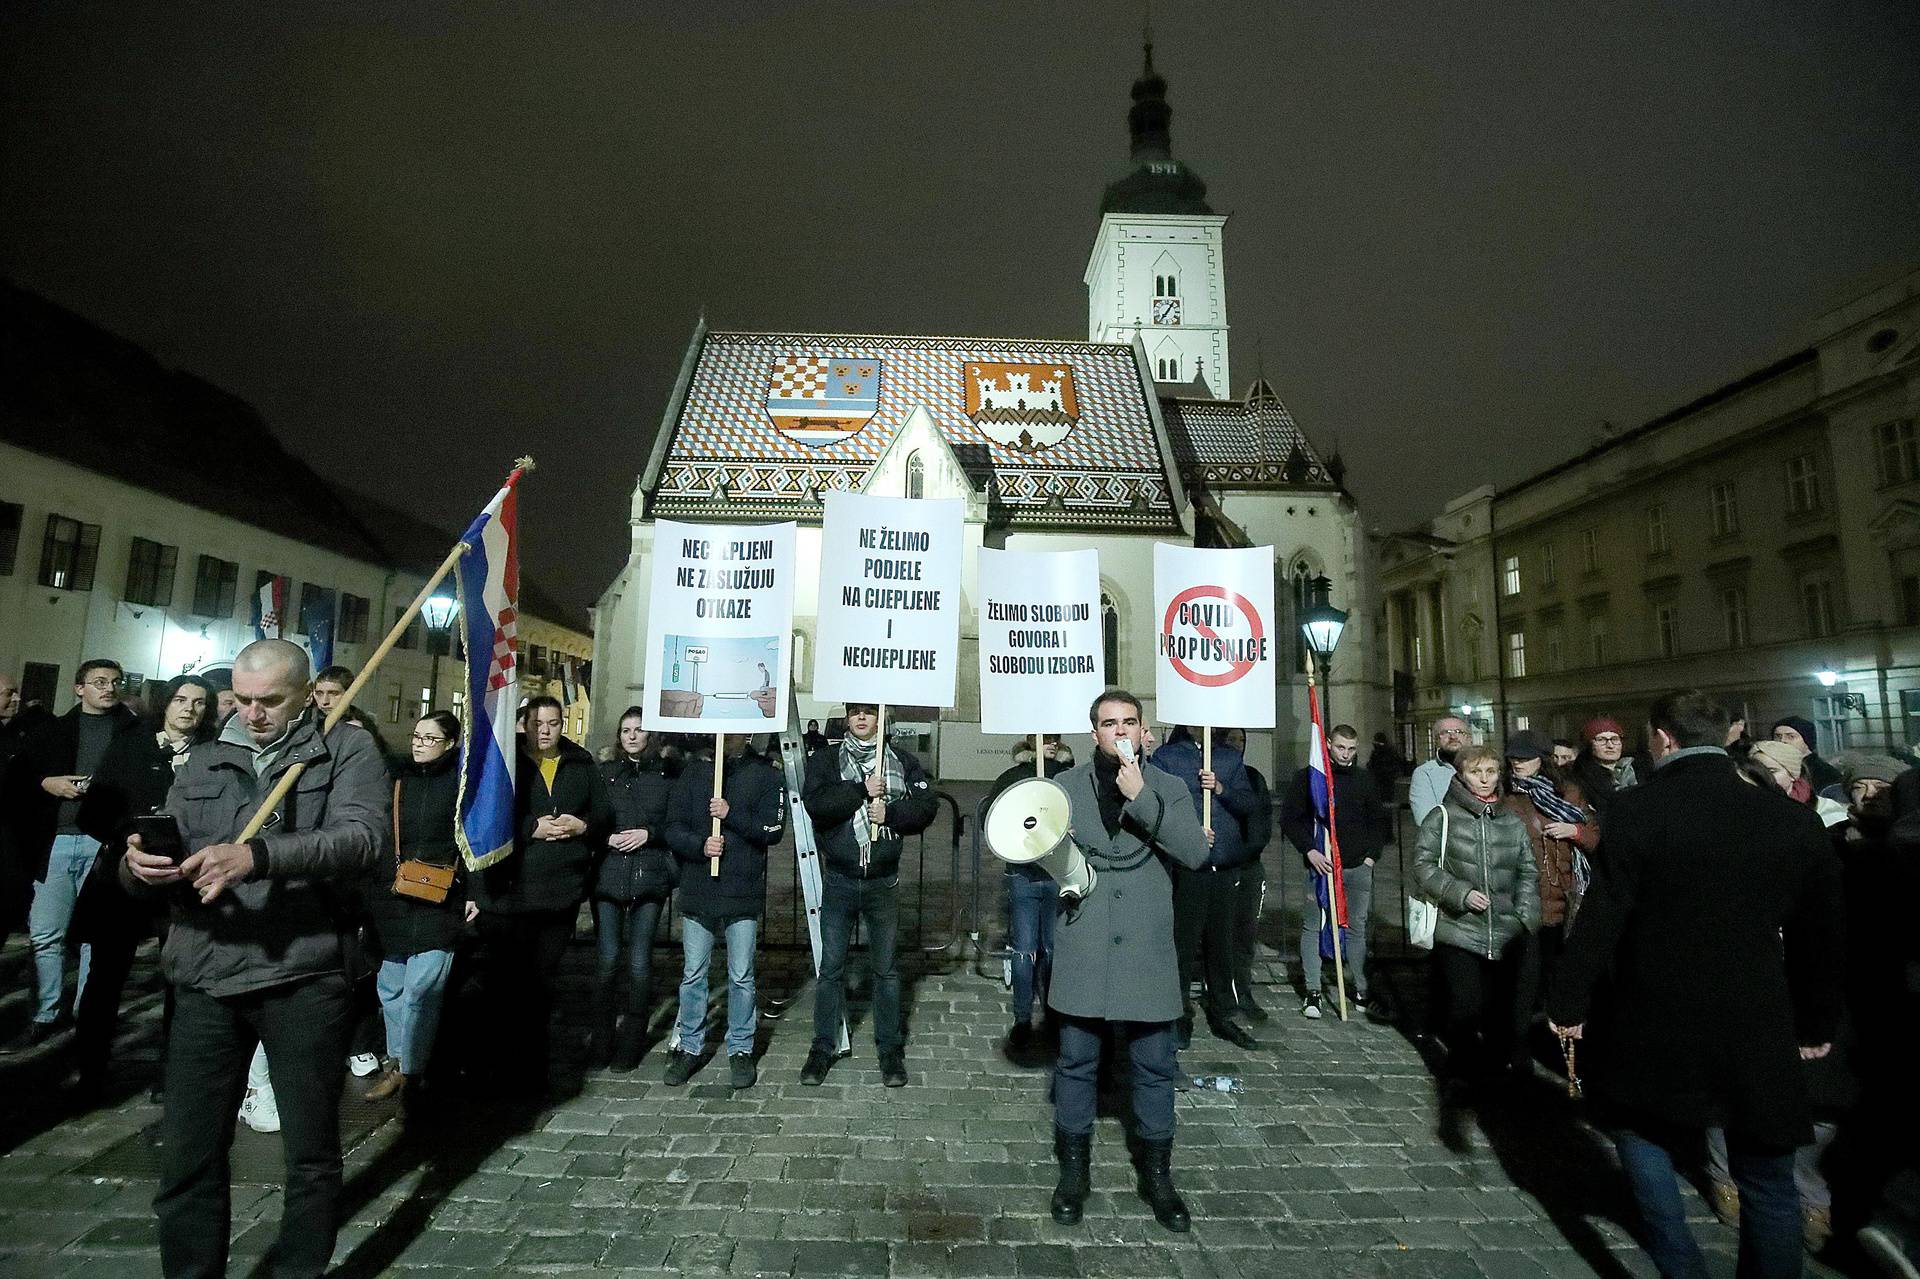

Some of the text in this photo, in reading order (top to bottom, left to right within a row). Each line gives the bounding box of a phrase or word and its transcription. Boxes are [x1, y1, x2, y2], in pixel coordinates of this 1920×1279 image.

[860, 525, 929, 551] NE ŽELIMO
[677, 566, 695, 588] NE
[864, 558, 922, 581] PODJELE
[696, 597, 752, 619] OTKAZE
[842, 585, 941, 611] NA CIJEPLJENE
[987, 598, 1090, 625] ŽELIMO SLOBODU
[1179, 602, 1234, 628] COVID
[887, 618, 893, 639] I
[1008, 629, 1068, 650] GOVORA I
[842, 645, 937, 671] NECIJEPLJENE
[1160, 632, 1267, 662] PROPUSNICE
[989, 654, 1095, 676] SLOBODU IZBORA
